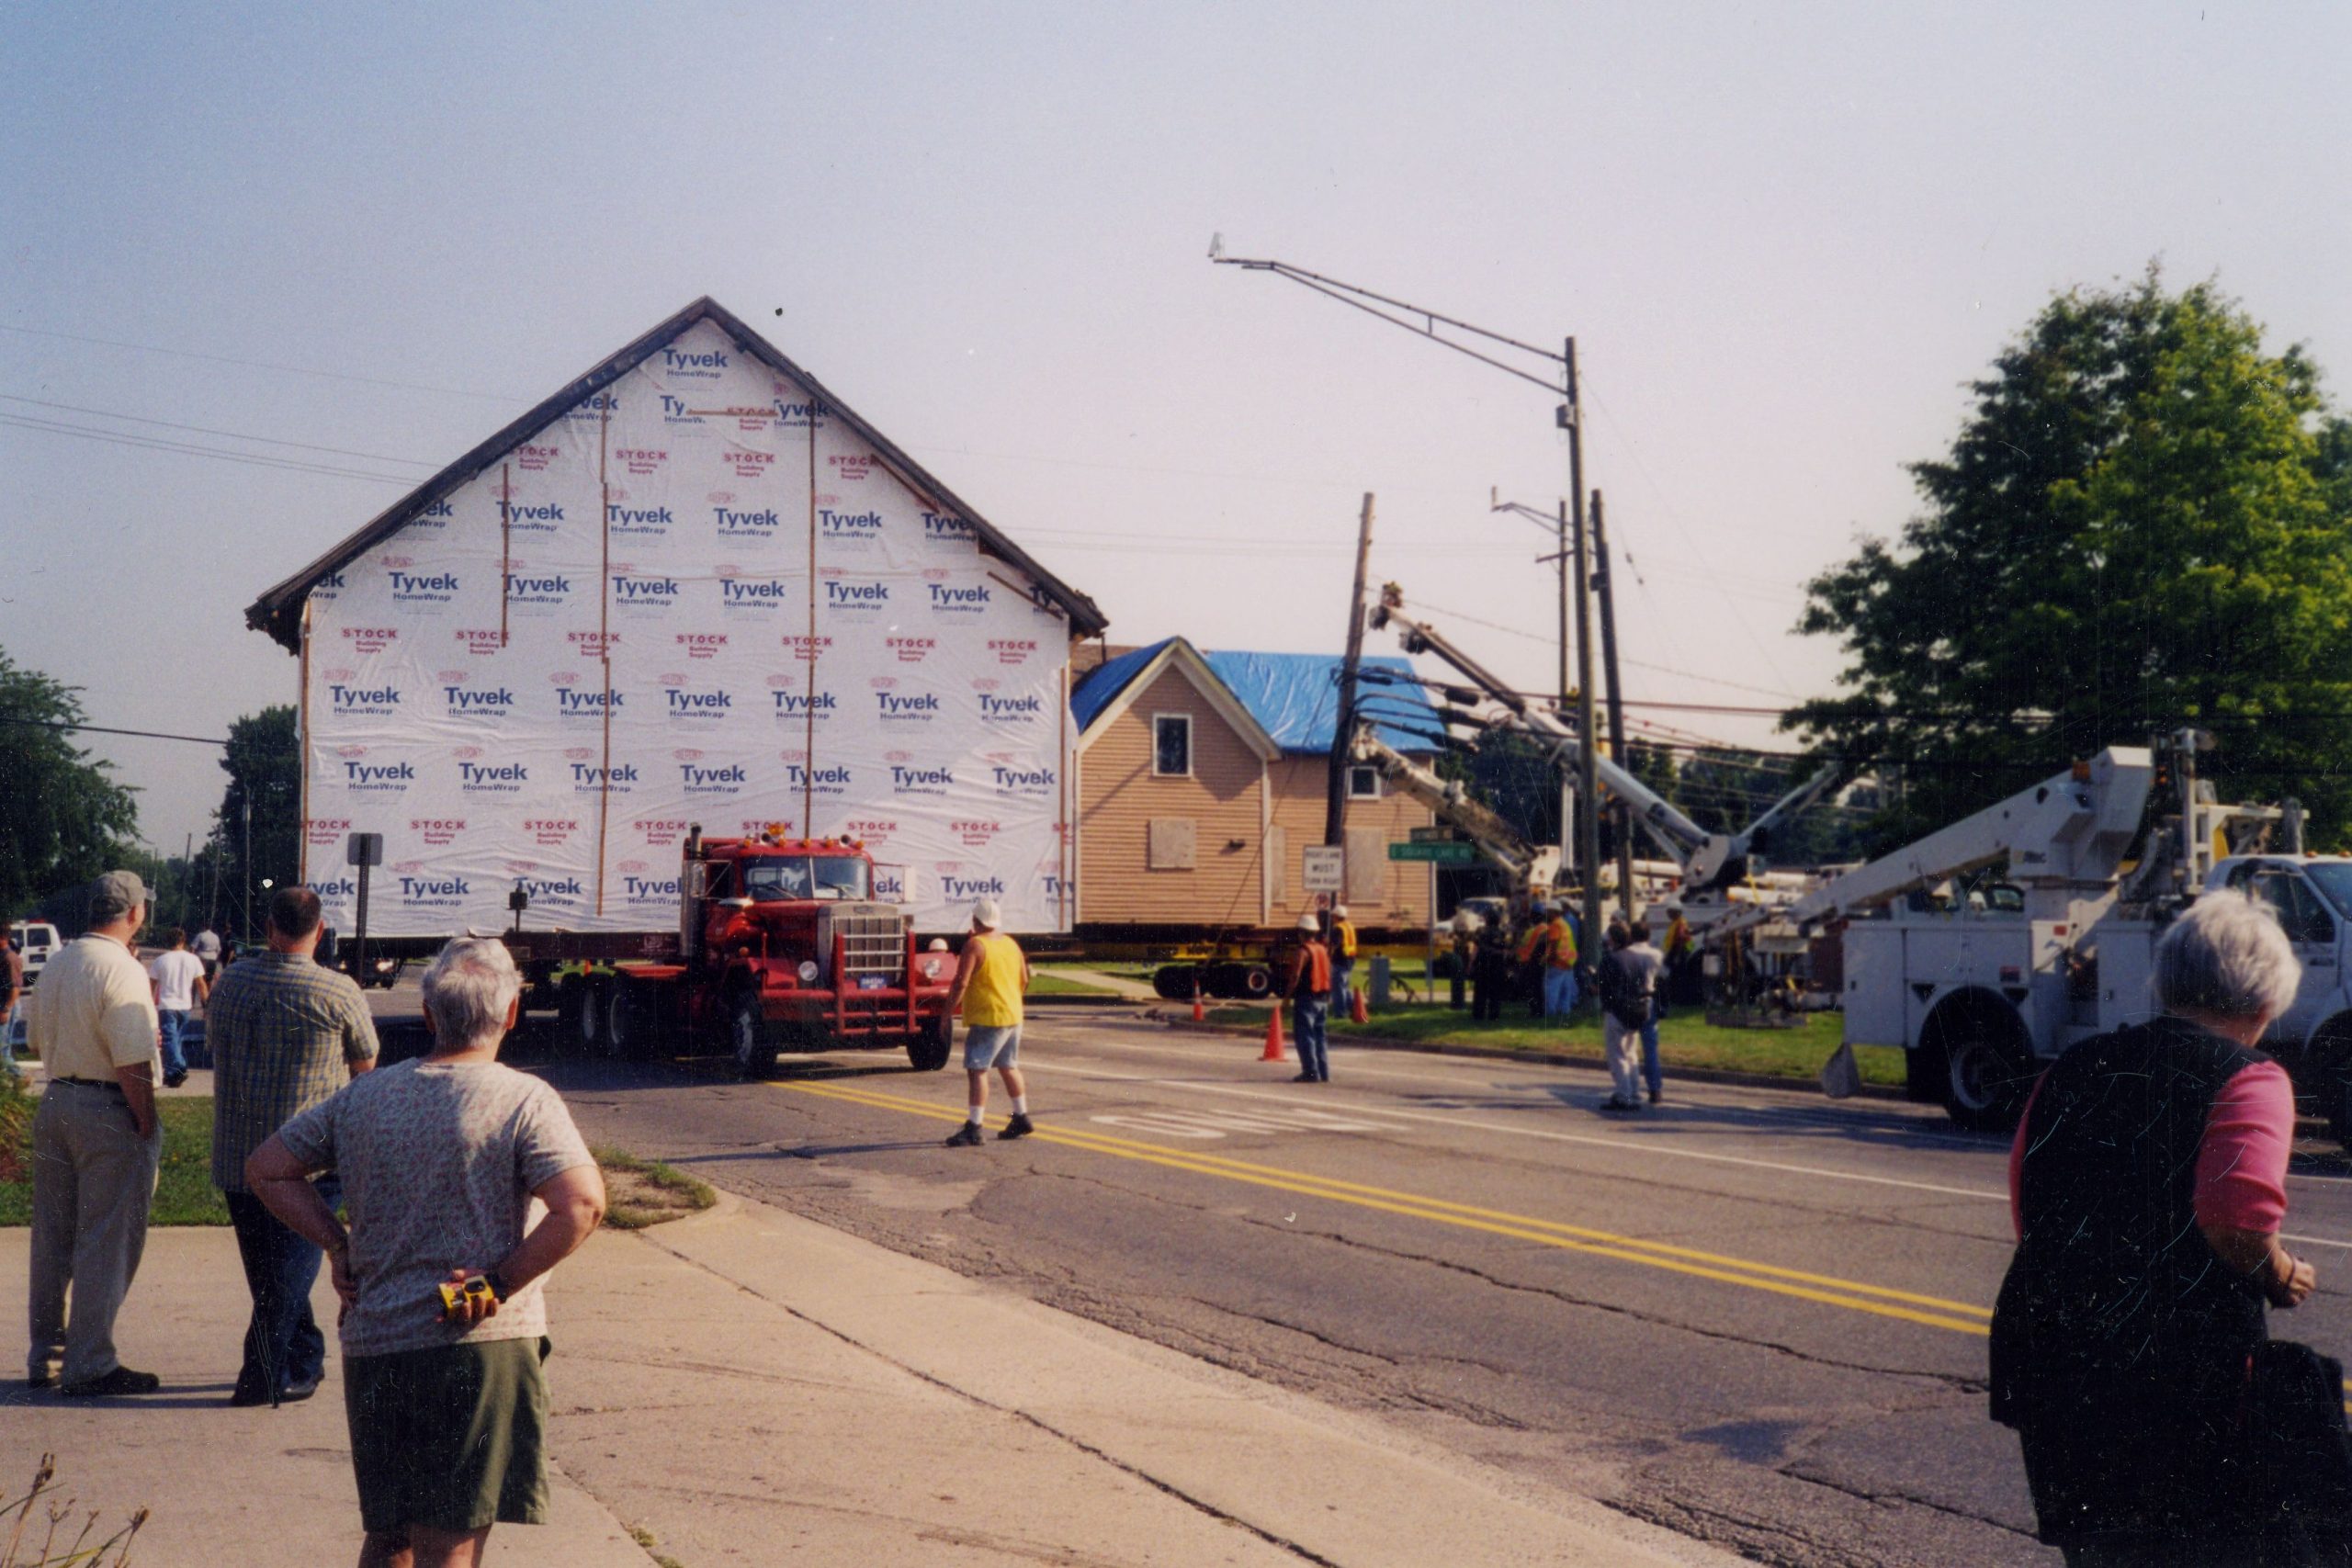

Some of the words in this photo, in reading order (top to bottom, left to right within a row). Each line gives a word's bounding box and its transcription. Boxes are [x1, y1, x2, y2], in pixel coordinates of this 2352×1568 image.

[663, 349, 728, 368] Tyvek
[667, 369, 721, 378] HomeWrap
[518, 446, 559, 456] TOCK
[616, 450, 667, 459] STOCK
[724, 454, 775, 463] STOCK
[496, 501, 564, 522] Tyvek
[608, 504, 673, 525] Tyvek
[714, 508, 779, 527] Tyvek
[820, 511, 882, 530] Tyvek
[611, 525, 666, 535] HomeWrap
[718, 528, 772, 536] HomeWrap
[823, 530, 876, 539] HomeWrap
[389, 572, 458, 592] Tyvek
[502, 574, 570, 594] Tyvek
[613, 577, 678, 598] Tyvek
[720, 580, 785, 600] Tyvek
[825, 581, 888, 601] Tyvek
[393, 592, 451, 602] HomeWrap
[928, 584, 990, 604] Tyvek
[616, 598, 673, 606] HomeWrap
[724, 600, 778, 608] HomeWrap
[829, 602, 882, 611] HomeWrap
[932, 604, 984, 613] HomeWrap
[342, 628, 397, 638] STOCK
[677, 636, 728, 645] STOCK
[887, 637, 935, 648] STOCK
[989, 640, 1036, 650] STOCK
[689, 651, 714, 660] Supply
[330, 685, 401, 706] Tyvek
[444, 687, 514, 707] Tyvek
[557, 688, 624, 708] Tyvek
[665, 690, 731, 710] Tyvek
[773, 692, 836, 712] Tyvek
[876, 693, 938, 713] Tyvek
[978, 694, 1040, 715] Tyvek
[334, 706, 393, 716] HomeWrap
[449, 707, 506, 716] HomeWrap
[669, 710, 724, 720] HomeWrap
[880, 712, 934, 721] HomeWrap
[345, 761, 414, 783] Tyvek
[458, 762, 527, 783] Tyvek
[571, 763, 638, 784] Tyvek
[680, 765, 746, 786] Tyvek
[786, 766, 851, 786] Tyvek
[891, 766, 954, 787] Tyvek
[992, 768, 1055, 787] Tyvek
[348, 783, 407, 792] HomeWrap
[462, 784, 521, 793] HomeWrap
[684, 785, 740, 795] HomeWrap
[894, 786, 947, 795] HomeWrap
[412, 820, 467, 829] STOCK
[524, 820, 578, 830] STOCK
[635, 820, 687, 829] STOCK
[847, 821, 898, 831] STOCK
[951, 822, 1001, 831] STOCK
[424, 831, 455, 840] Building
[537, 831, 567, 840] Building
[1313, 863, 1334, 873] MUST
[399, 877, 469, 897] Tyvek
[514, 876, 581, 897] Tyvek
[941, 876, 1004, 897] Tyvek
[403, 897, 462, 908] HomeWrap
